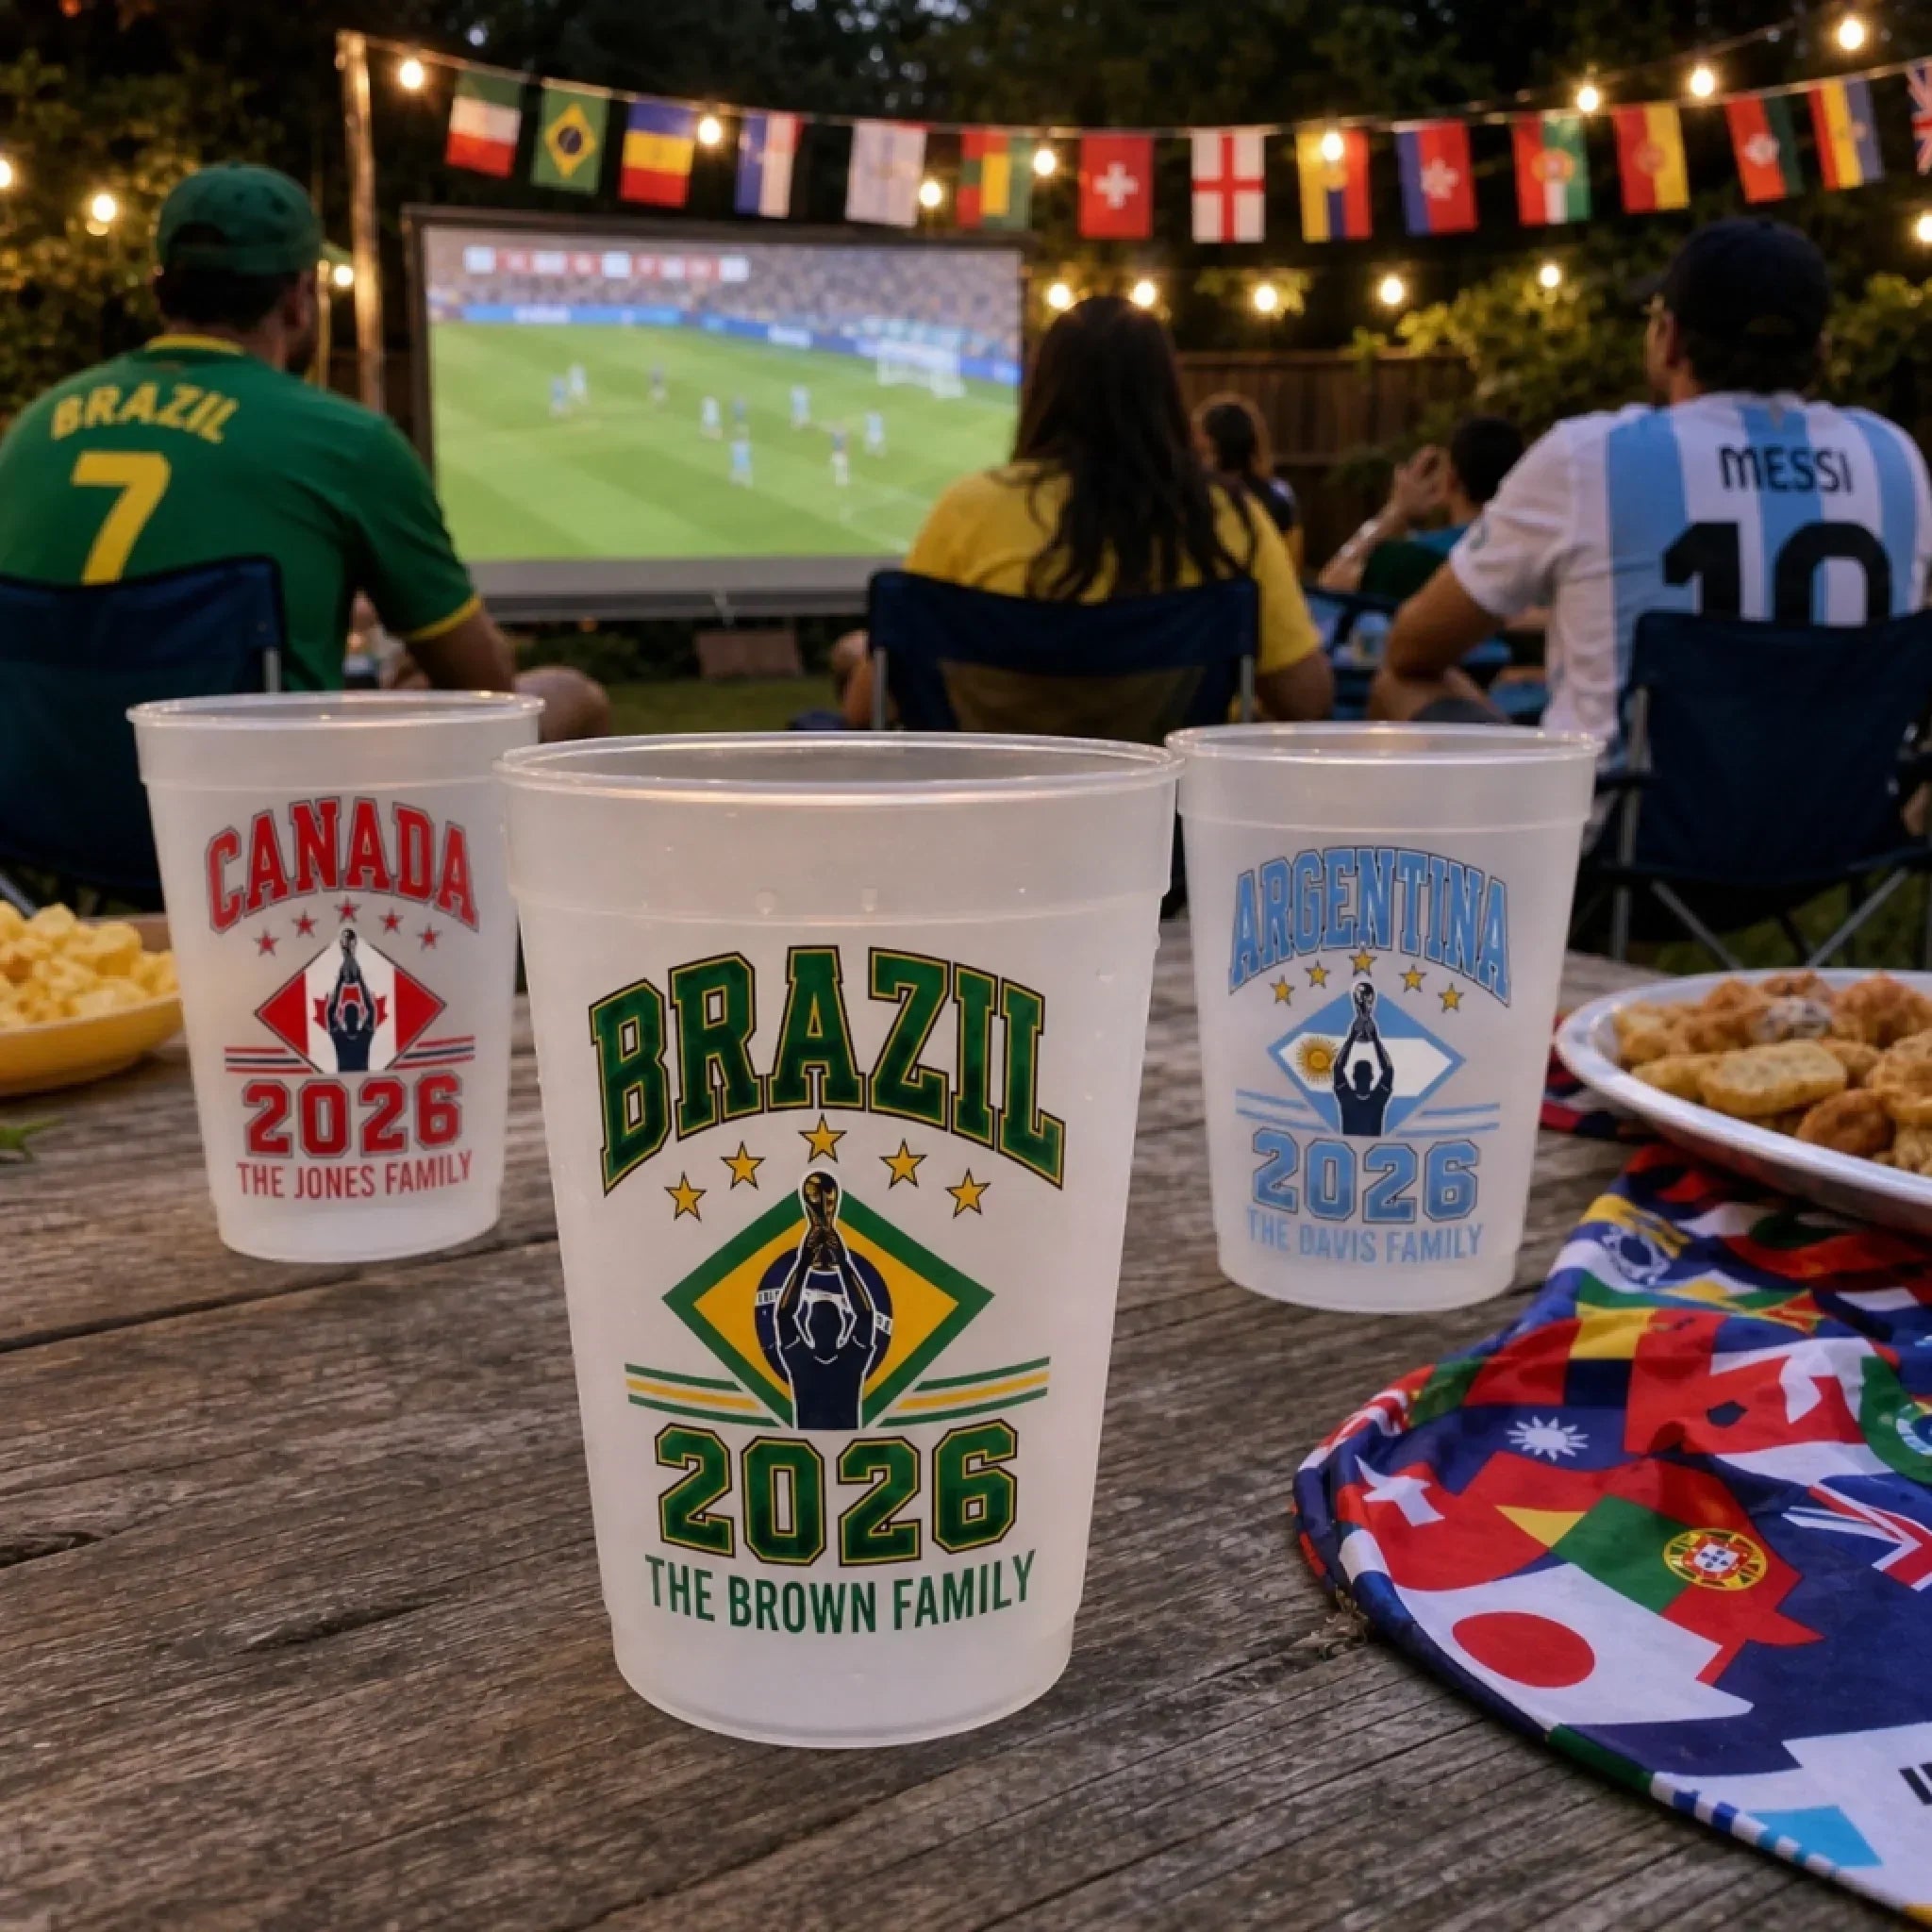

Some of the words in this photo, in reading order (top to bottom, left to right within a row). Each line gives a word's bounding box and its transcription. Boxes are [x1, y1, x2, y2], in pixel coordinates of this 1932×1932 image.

[51, 382, 240, 443] BRAZIL
[71, 451, 172, 585] 7
[1719, 444, 1853, 494] MESSI
[1663, 521, 1892, 627] 10
[205, 796, 479, 934] CANADA
[1228, 845, 1510, 1008] ARGENTINA
[242, 1070, 463, 1158] 2026
[589, 945, 1066, 1197] BRAZIL
[236, 1162, 285, 1198] THE
[294, 1163, 375, 1199] JONES
[385, 1150, 474, 1195] FAMILY
[1252, 1125, 1480, 1224] 2026
[1247, 1207, 1290, 1251] THE
[1299, 1224, 1376, 1262] DAVIS
[1386, 1223, 1484, 1263] FAMILY
[655, 1418, 1019, 1567] 2026
[644, 1554, 716, 1623] THE
[728, 1574, 876, 1634] BROWN
[893, 1548, 1036, 1631] FAMILY
